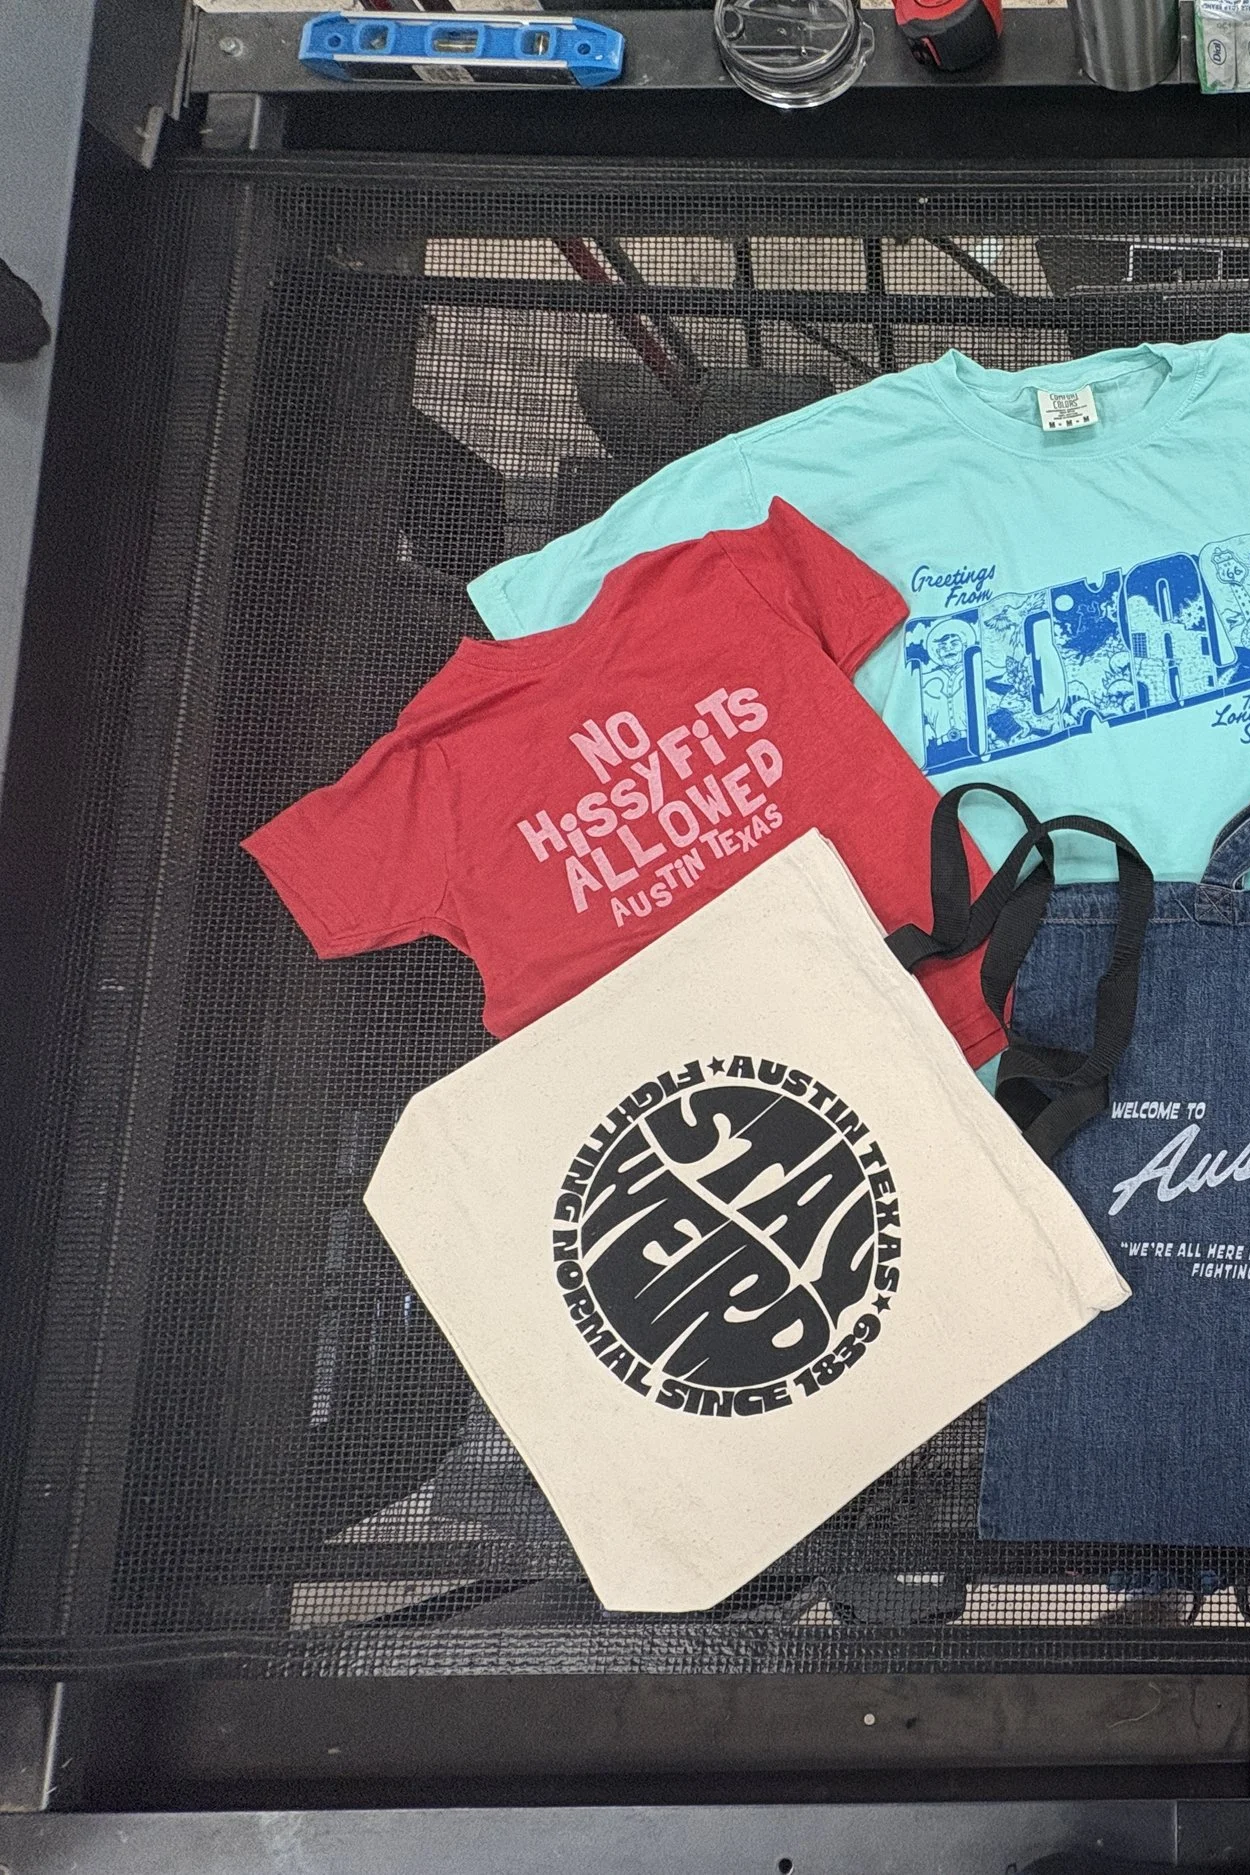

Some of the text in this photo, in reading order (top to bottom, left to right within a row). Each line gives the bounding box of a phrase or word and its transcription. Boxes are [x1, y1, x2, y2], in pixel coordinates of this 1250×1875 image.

[1213, 42, 1221, 62] Dial
[1053, 400, 1078, 409] COLORS
[911, 563, 996, 593] Greetings
[944, 586, 993, 609] From
[569, 711, 651, 784] NO
[564, 738, 783, 914] ALLOWED
[699, 803, 783, 860] TEXAS
[1111, 1101, 1206, 1119] WELCOME TO
[726, 1055, 902, 1292] AUSTIN TEXAS
[552, 1060, 882, 1418] FIGHTING NORMAL SINCE 1839
[580, 1125, 831, 1388] WEIRD
[1177, 1244, 1203, 1258] ALL
[1208, 1244, 1244, 1261] HERE
